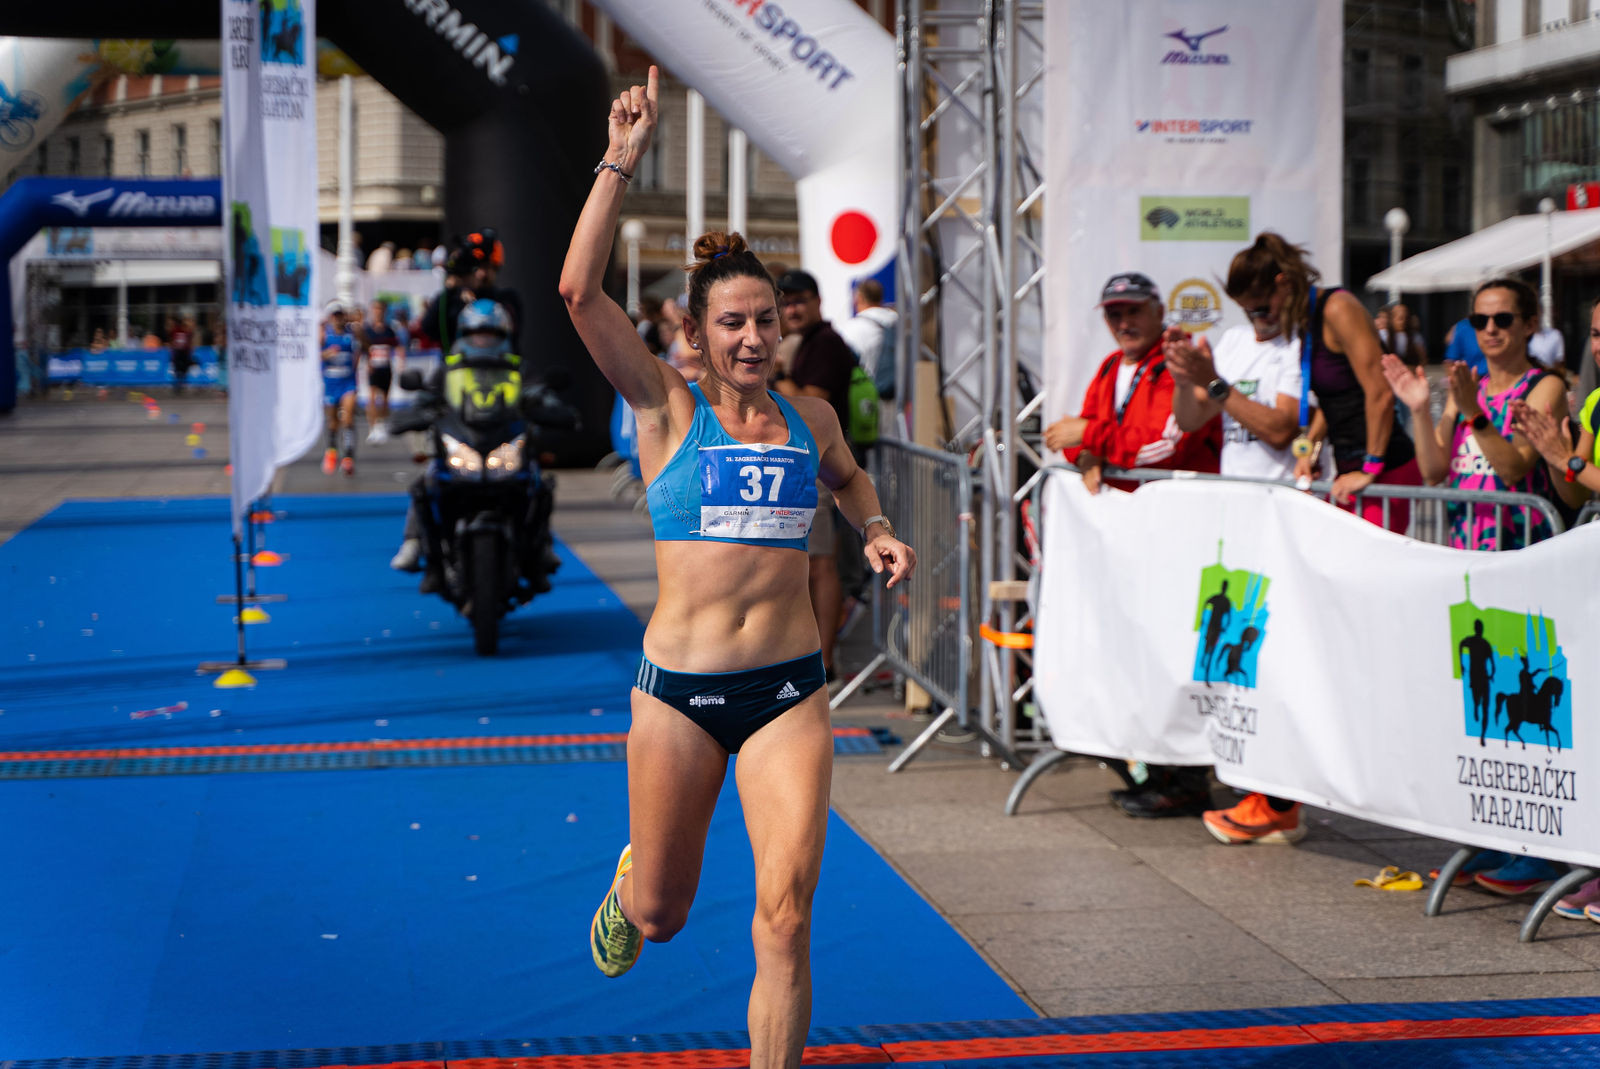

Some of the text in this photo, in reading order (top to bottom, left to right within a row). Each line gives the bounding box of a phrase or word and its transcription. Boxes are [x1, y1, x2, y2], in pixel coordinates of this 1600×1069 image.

[1151, 119, 1252, 133] INTERSPORT
[1184, 208, 1226, 217] WORLD
[1183, 218, 1245, 228] ATHLETICS
[739, 465, 785, 502] 37
[776, 690, 800, 700] adidas
[1457, 755, 1577, 801] ZAGREBAČKI
[1470, 793, 1563, 836] MARATON
